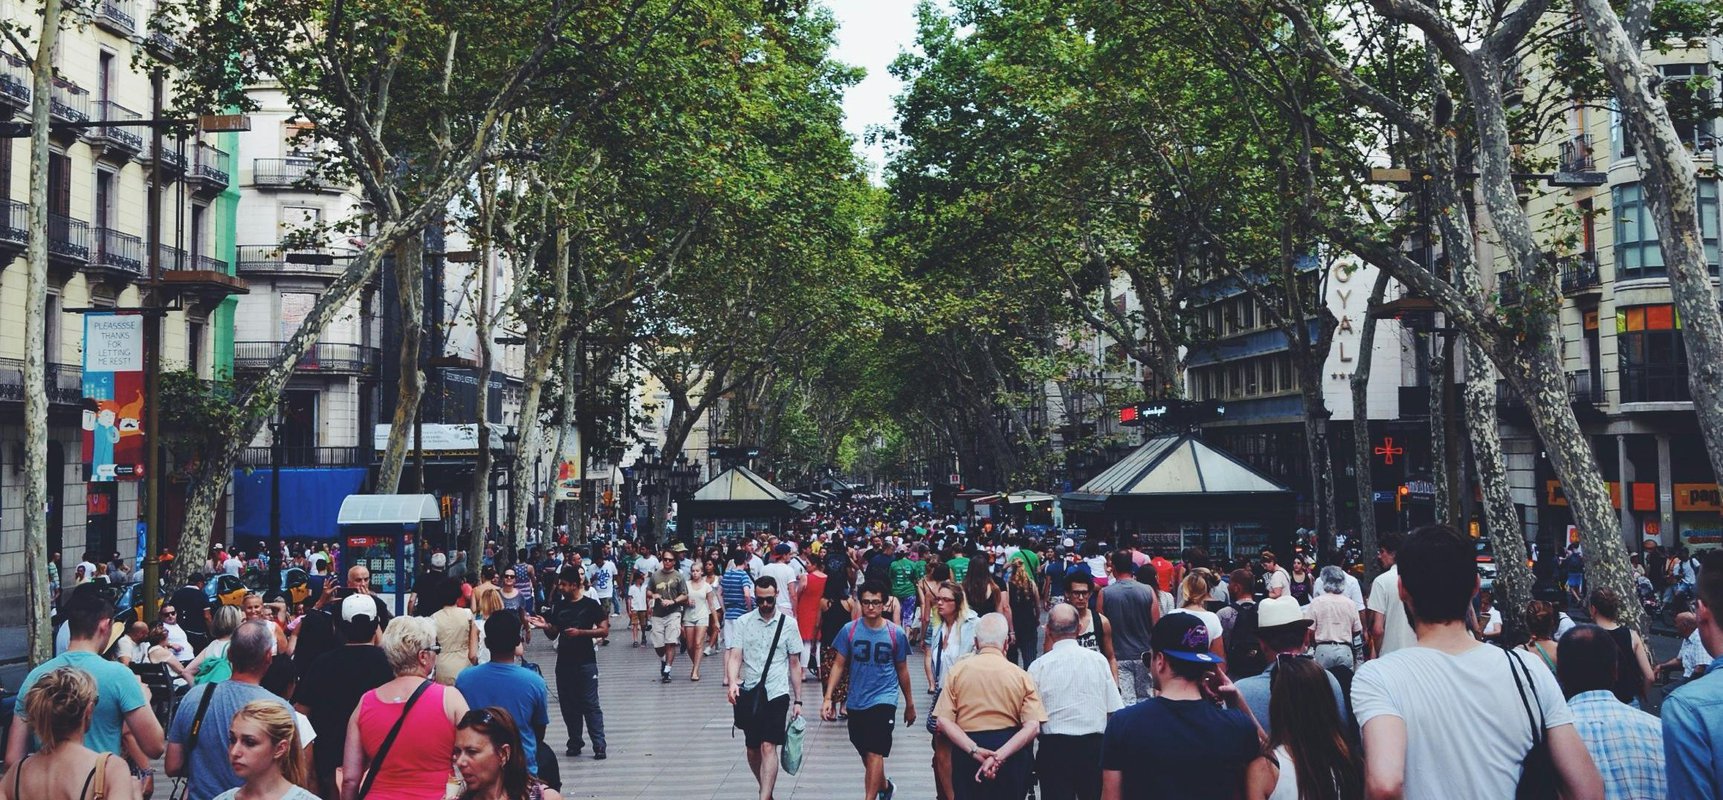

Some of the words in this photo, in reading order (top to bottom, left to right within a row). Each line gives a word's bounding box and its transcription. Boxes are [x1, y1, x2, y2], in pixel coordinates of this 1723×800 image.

[101, 332, 130, 340] THANKS
[107, 341, 122, 349] FOR
[98, 349, 131, 357] LETTING
[854, 640, 893, 664] 36
